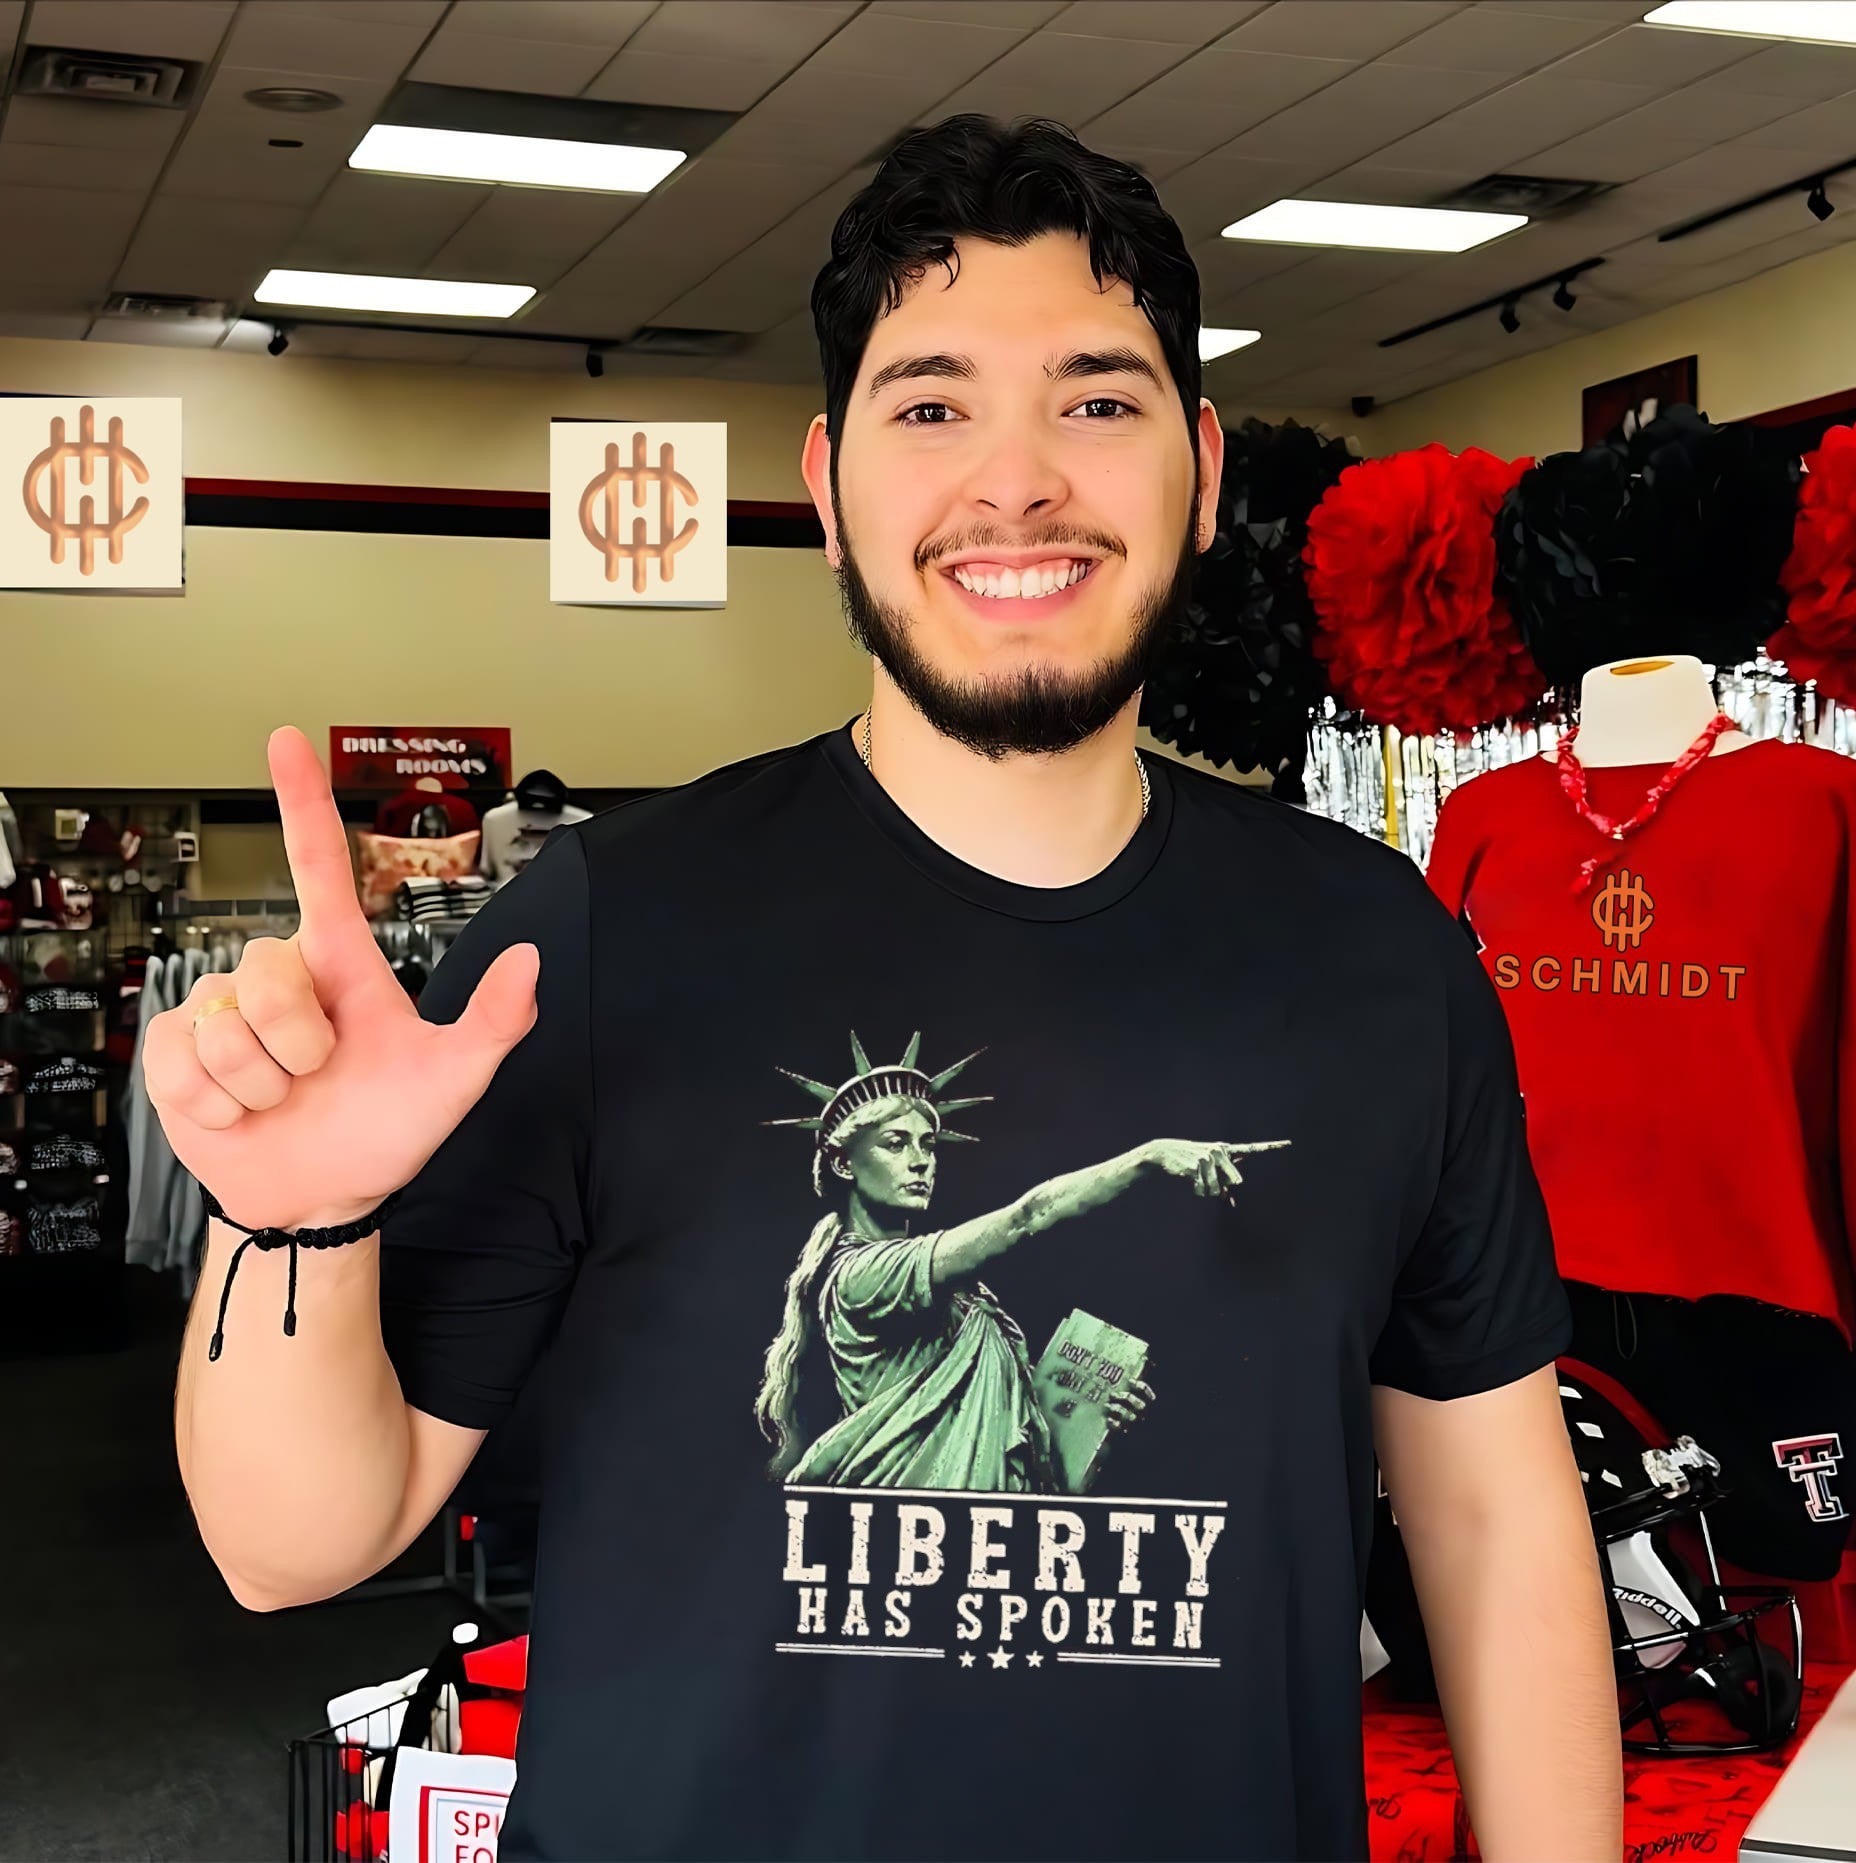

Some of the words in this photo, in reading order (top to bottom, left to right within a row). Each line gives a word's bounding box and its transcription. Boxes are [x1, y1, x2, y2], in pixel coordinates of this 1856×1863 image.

[342, 737, 467, 754] DRESSING
[396, 758, 487, 775] ROOMS
[1494, 954, 1747, 1001] SCHMIDT
[783, 1500, 1225, 1596] LIBERTY
[797, 1588, 911, 1637] HAS
[956, 1594, 1204, 1649] SPOKEN
